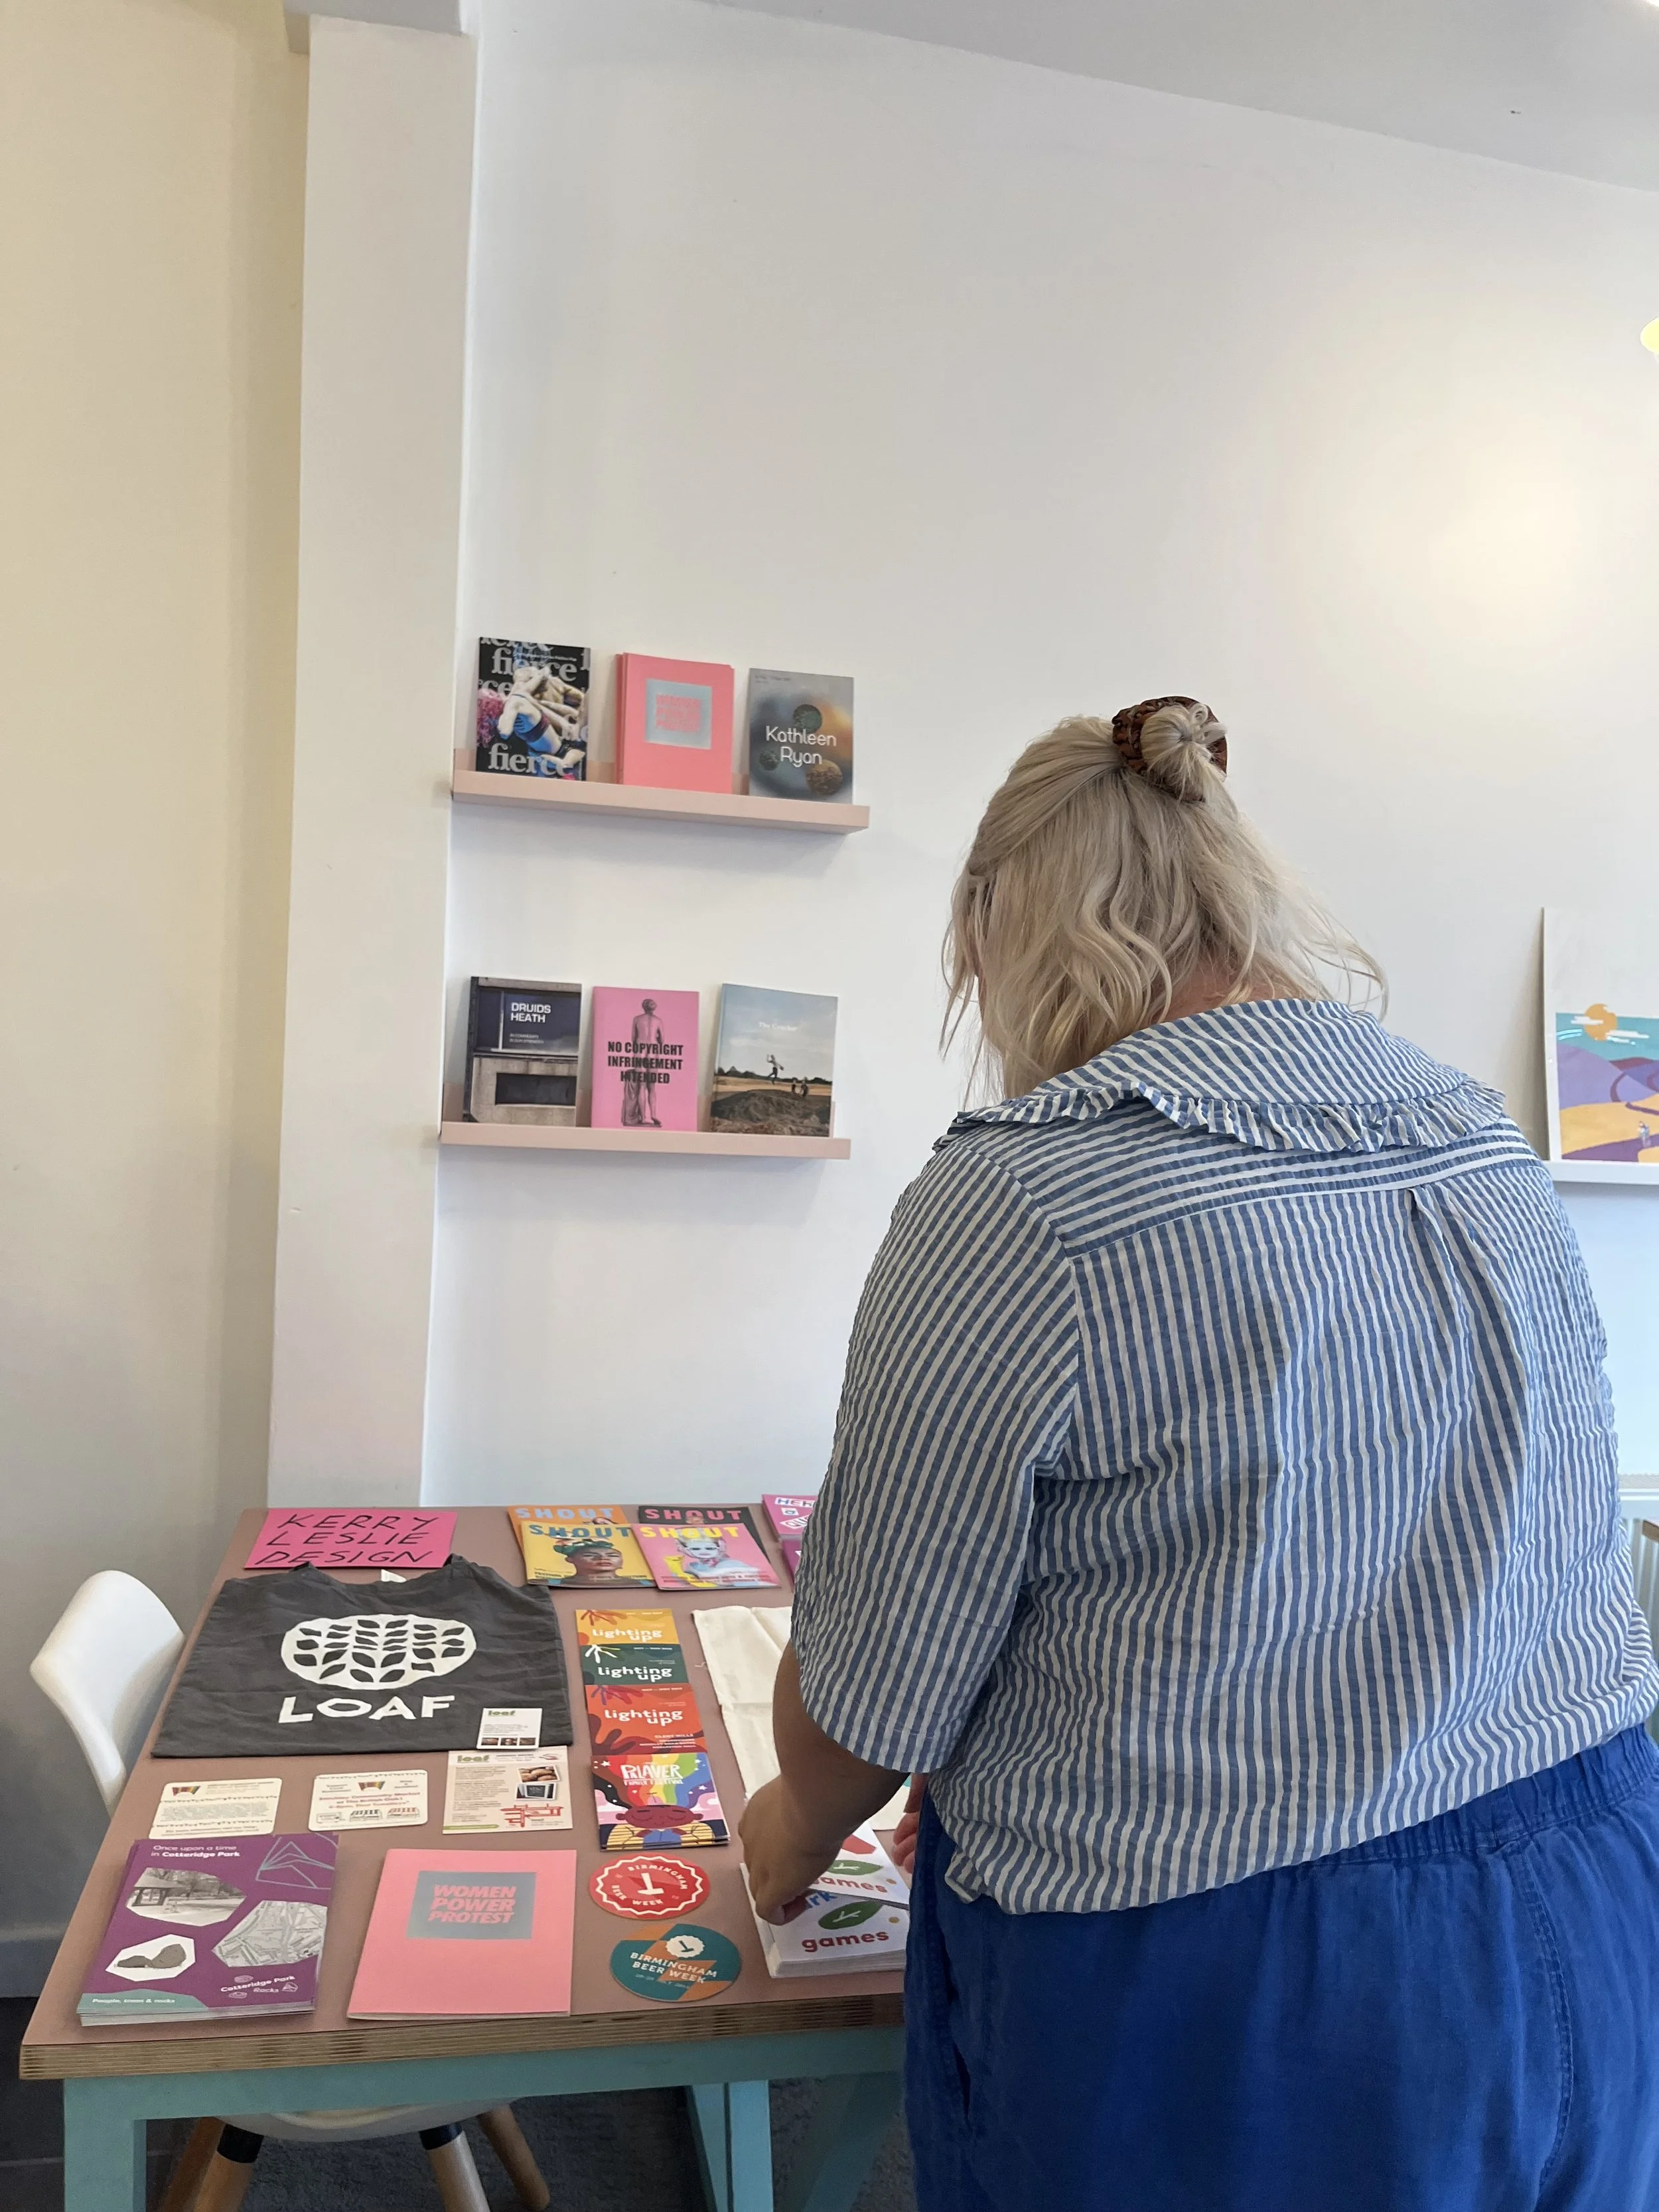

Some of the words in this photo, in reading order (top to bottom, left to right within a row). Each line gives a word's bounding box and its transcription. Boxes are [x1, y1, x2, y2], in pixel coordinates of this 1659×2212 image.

[766, 725, 837, 747] Kathleen
[780, 746, 823, 767] Ryan
[511, 1002, 551, 1013] DRUIDS
[510, 1013, 546, 1023] HEATH
[608, 1041, 622, 1053] NO
[624, 1042, 684, 1055] COPYRIGHT
[608, 1056, 684, 1070] INFRINGEMENT
[620, 1070, 670, 1083] INTENDED
[515, 1507, 614, 1519] SHOUT
[644, 1509, 742, 1520] SHOUT
[277, 1514, 439, 1531] KERRY
[528, 1524, 631, 1538] SHOUT
[640, 1526, 741, 1539] SHOUT
[267, 1531, 430, 1546] LESLIE
[254, 1550, 433, 1566] DESIGN
[598, 1666, 672, 1678] lighting
[638, 1674, 662, 1682] up
[279, 1695, 455, 1724] LOAF
[605, 1710, 683, 1722] lighting
[647, 1717, 673, 1726] up
[627, 1864, 688, 1889] BIRMINGHAM
[433, 1884, 517, 1898] WOMEN
[431, 1897, 516, 1912] POWER
[428, 1911, 516, 1924] PROTEST
[802, 1931, 890, 1953] games
[630, 1952, 717, 1978] BIRMINGHAM
[632, 1961, 666, 1974] BEER
[669, 1970, 706, 1984] WEEK
[220, 1980, 272, 1992] Cotteridge
